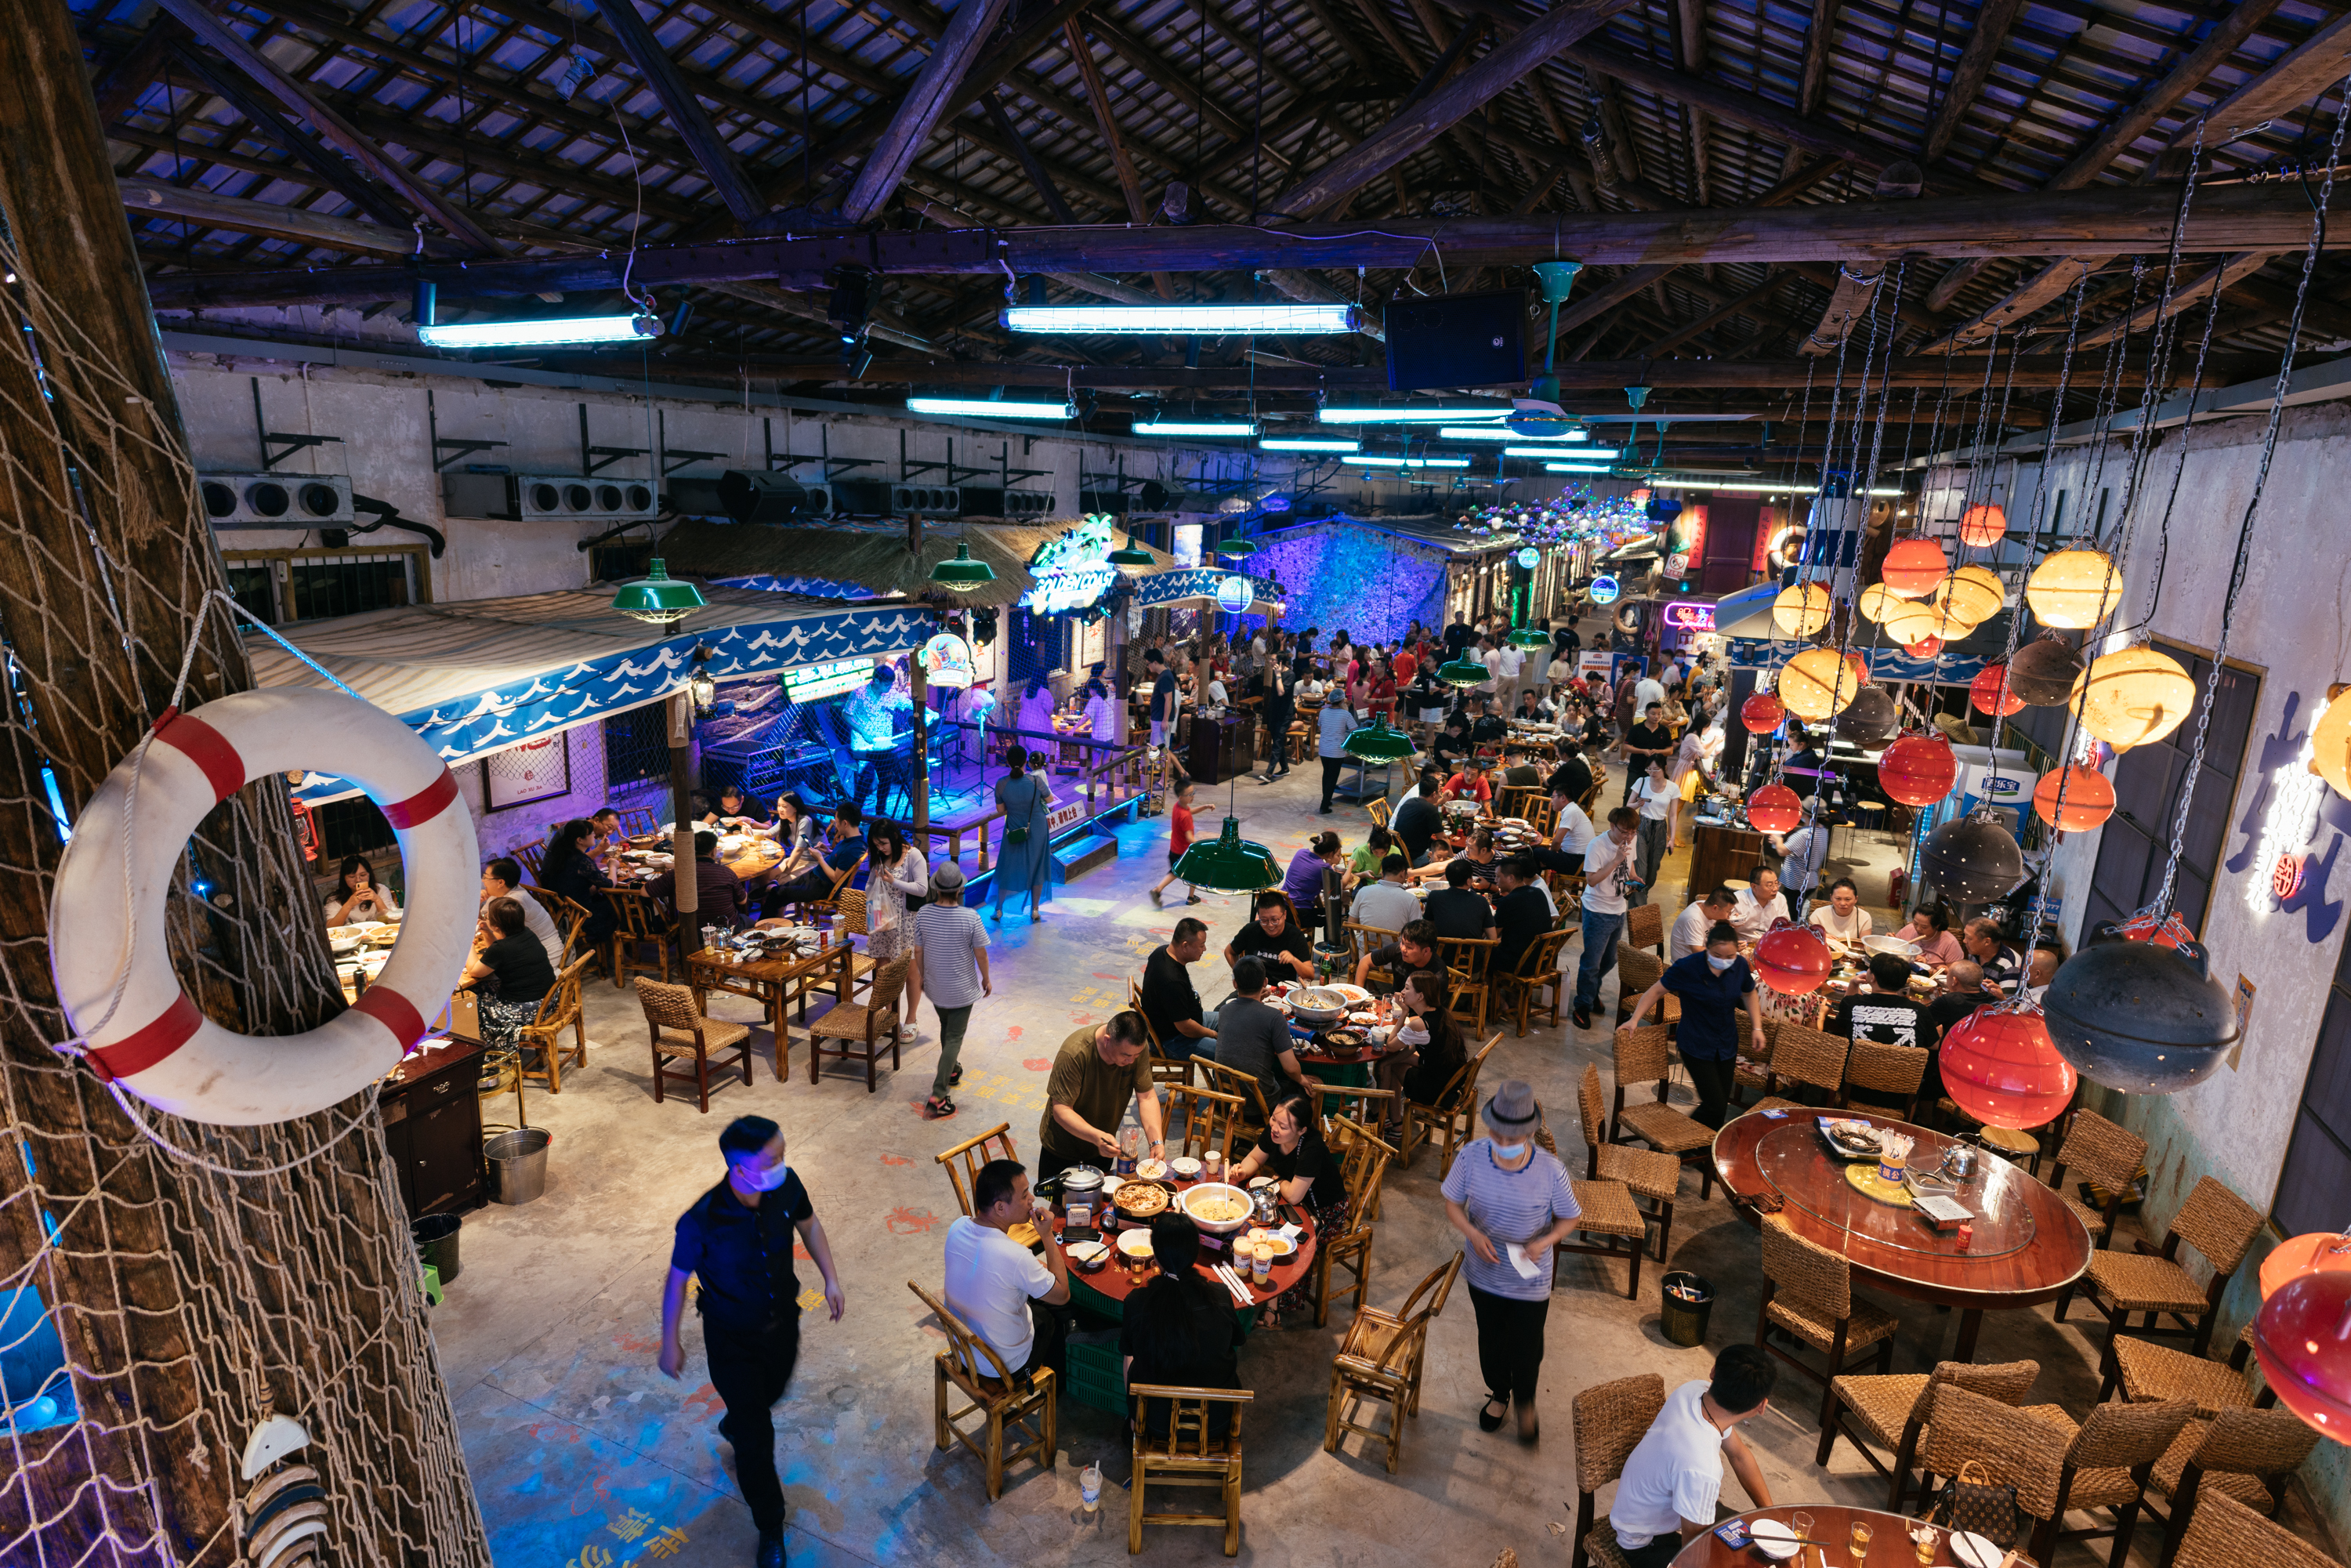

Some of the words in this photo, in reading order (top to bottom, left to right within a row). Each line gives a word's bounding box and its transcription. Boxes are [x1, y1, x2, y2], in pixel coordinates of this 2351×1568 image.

[1080, 570, 1118, 590] COAST
[1675, 607, 1710, 624] 服务
[1128, 1162, 1136, 1171] 公
